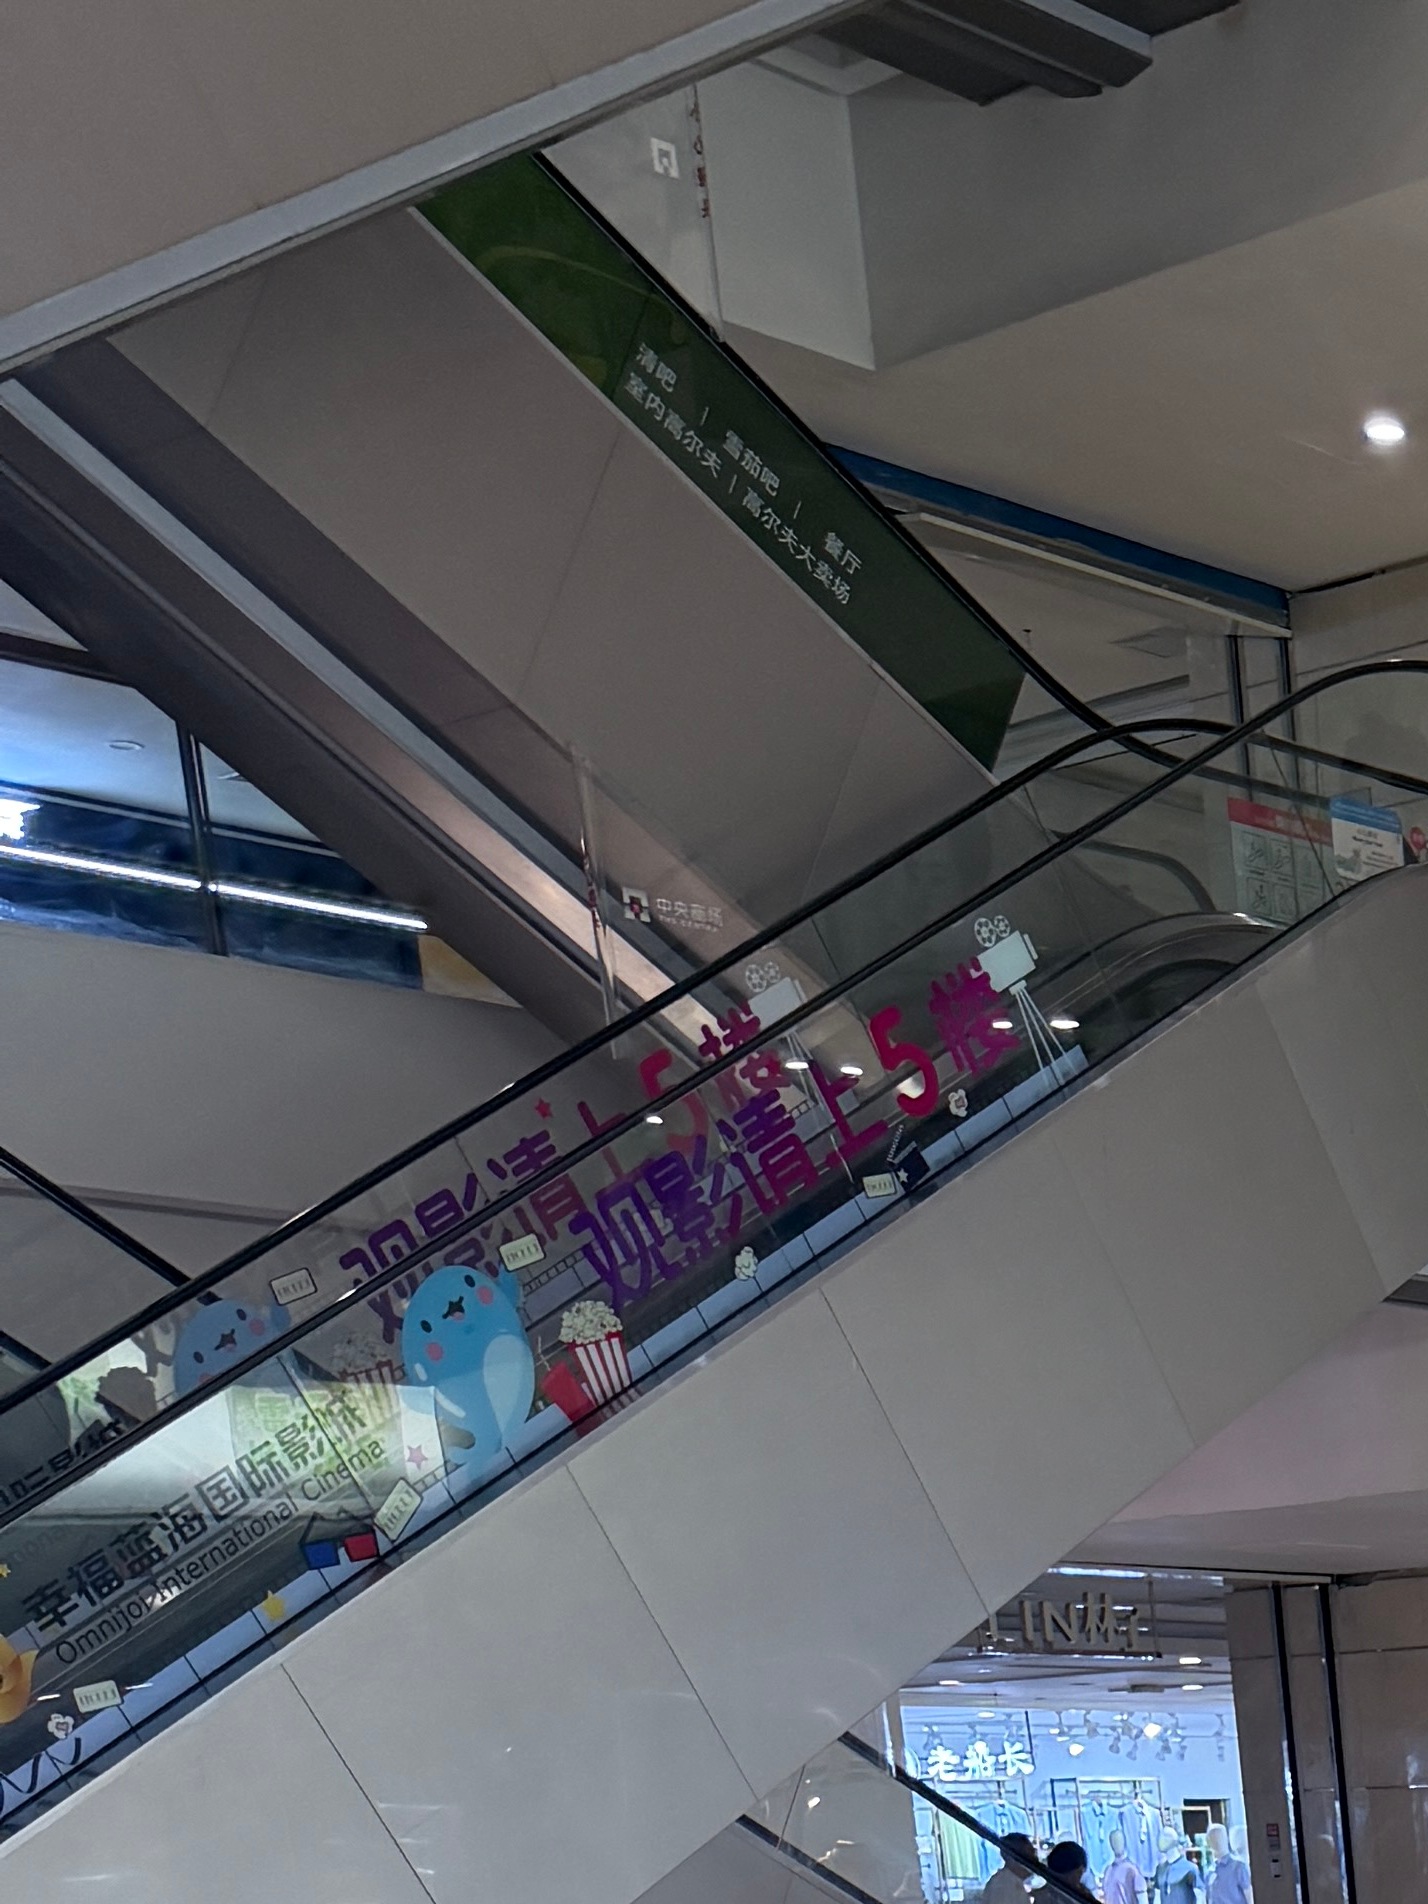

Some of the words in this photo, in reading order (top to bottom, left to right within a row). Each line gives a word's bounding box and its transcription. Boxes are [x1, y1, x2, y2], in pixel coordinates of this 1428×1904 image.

[624, 371, 722, 479] 室内高尔夫
[742, 486, 851, 604] 高尔夫大卖场
[23, 1389, 367, 1633] 幸福蓝海国际影城
[55, 1595, 151, 1665] Omnijoi
[153, 1495, 299, 1597] International
[301, 1438, 384, 1502] Cinema
[928, 1740, 1035, 1783] 老船长
